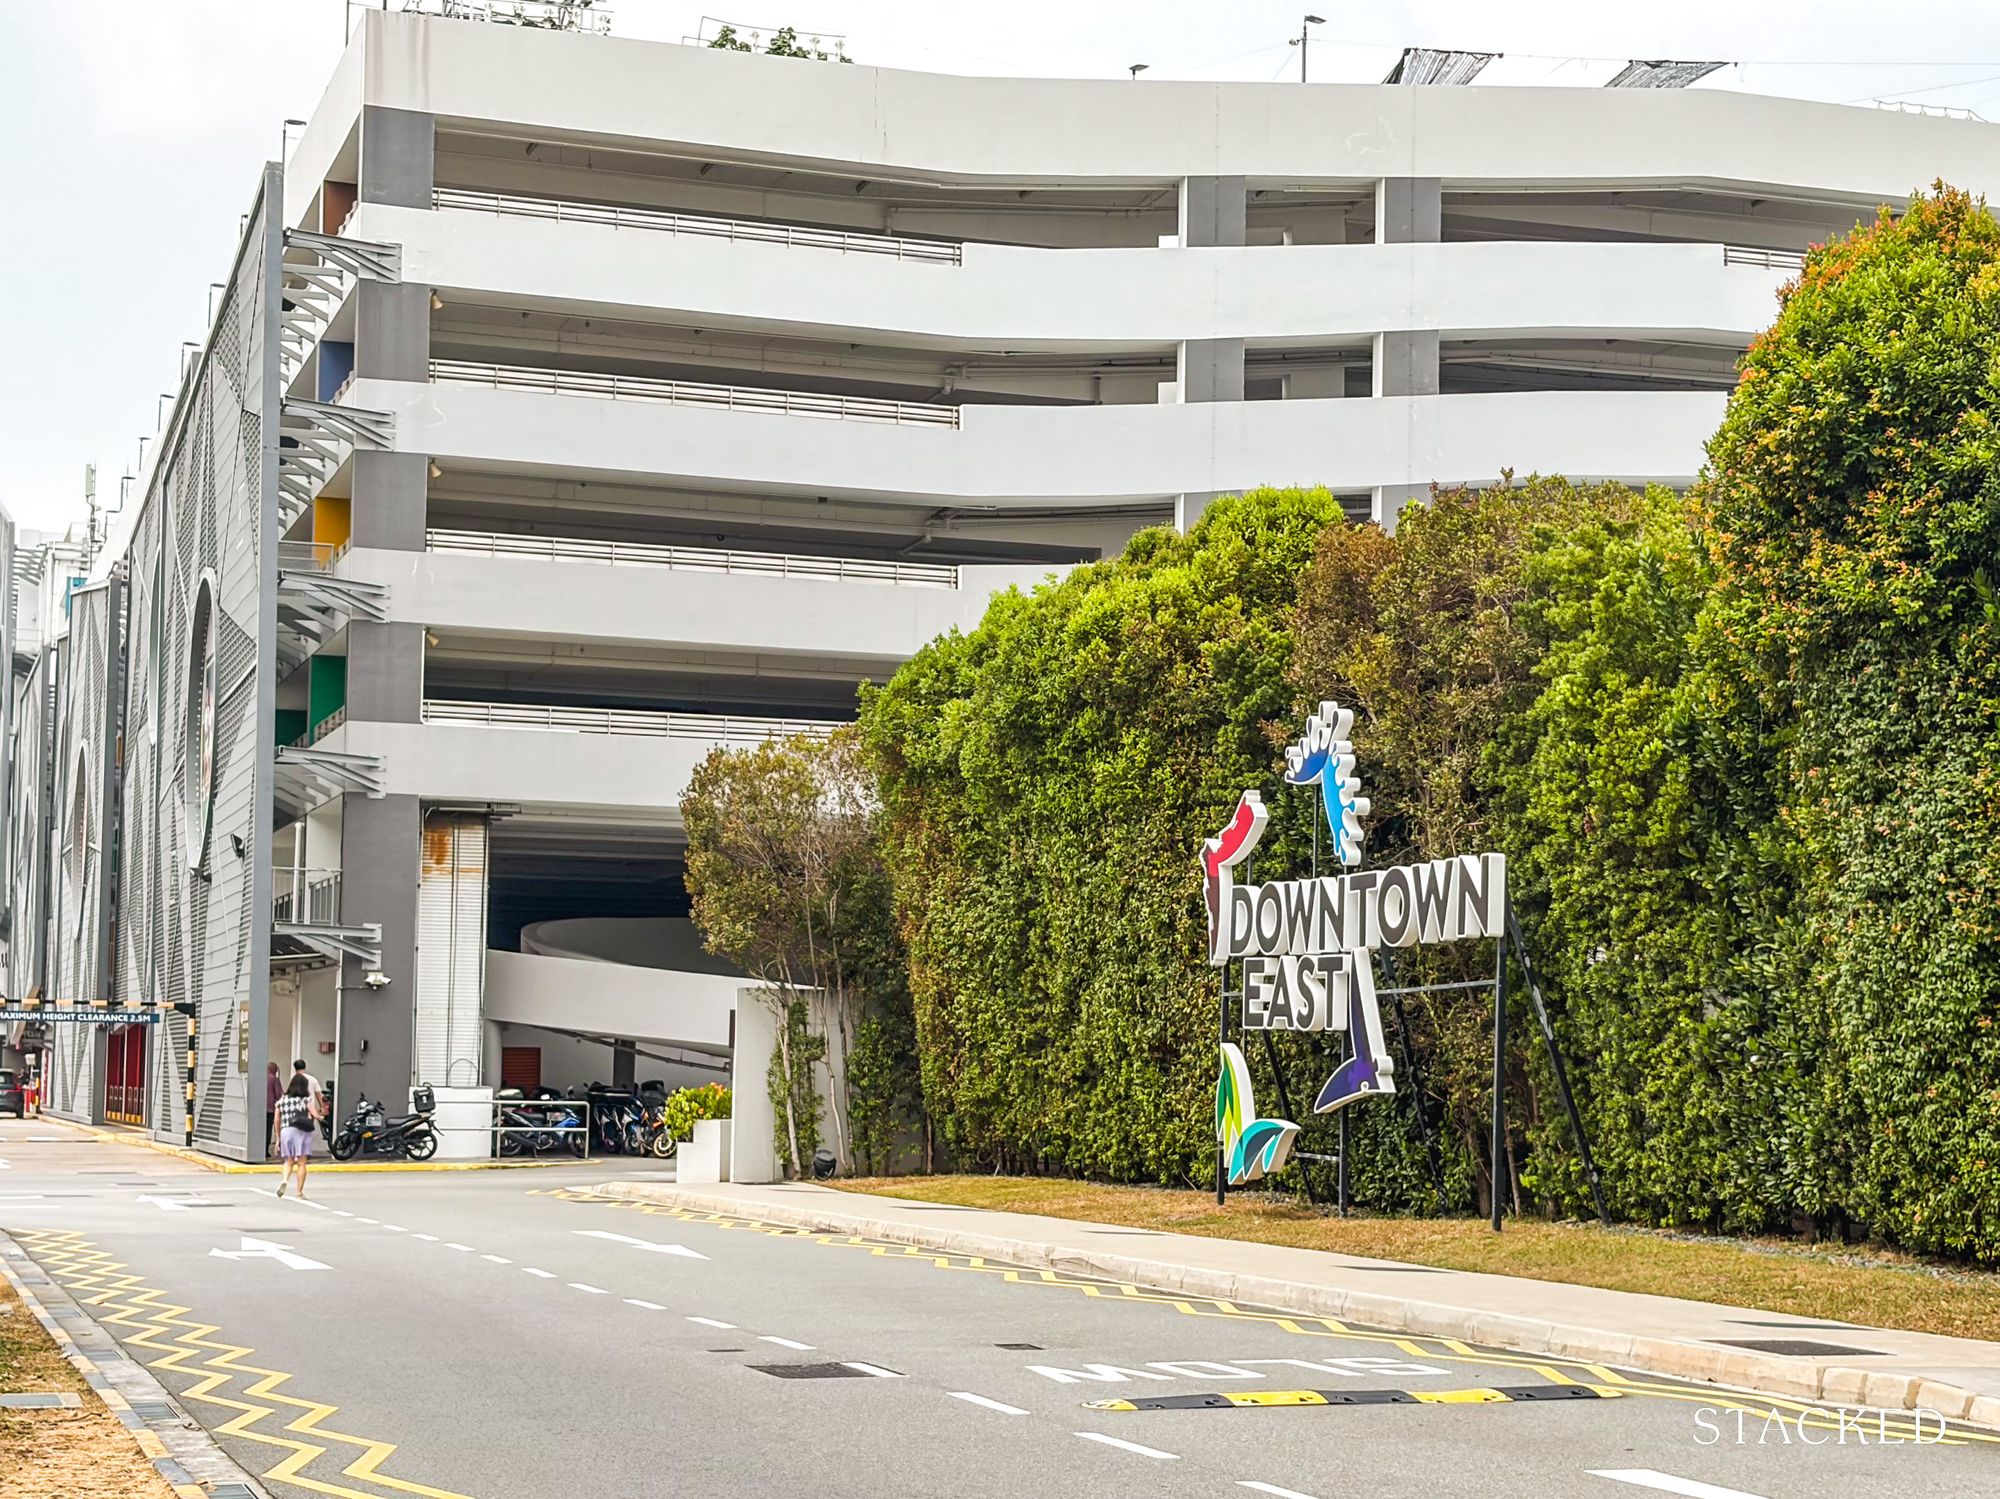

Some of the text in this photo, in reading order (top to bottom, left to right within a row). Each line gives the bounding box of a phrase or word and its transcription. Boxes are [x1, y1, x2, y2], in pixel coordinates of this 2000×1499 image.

[1230, 854, 1500, 955] DOWNTOWN
[42, 1012, 76, 1021] HEIGHT
[77, 1012, 128, 1022] CLEARANCE
[1244, 956, 1349, 1030] EAST
[1025, 1357, 1454, 1383] SLOW
